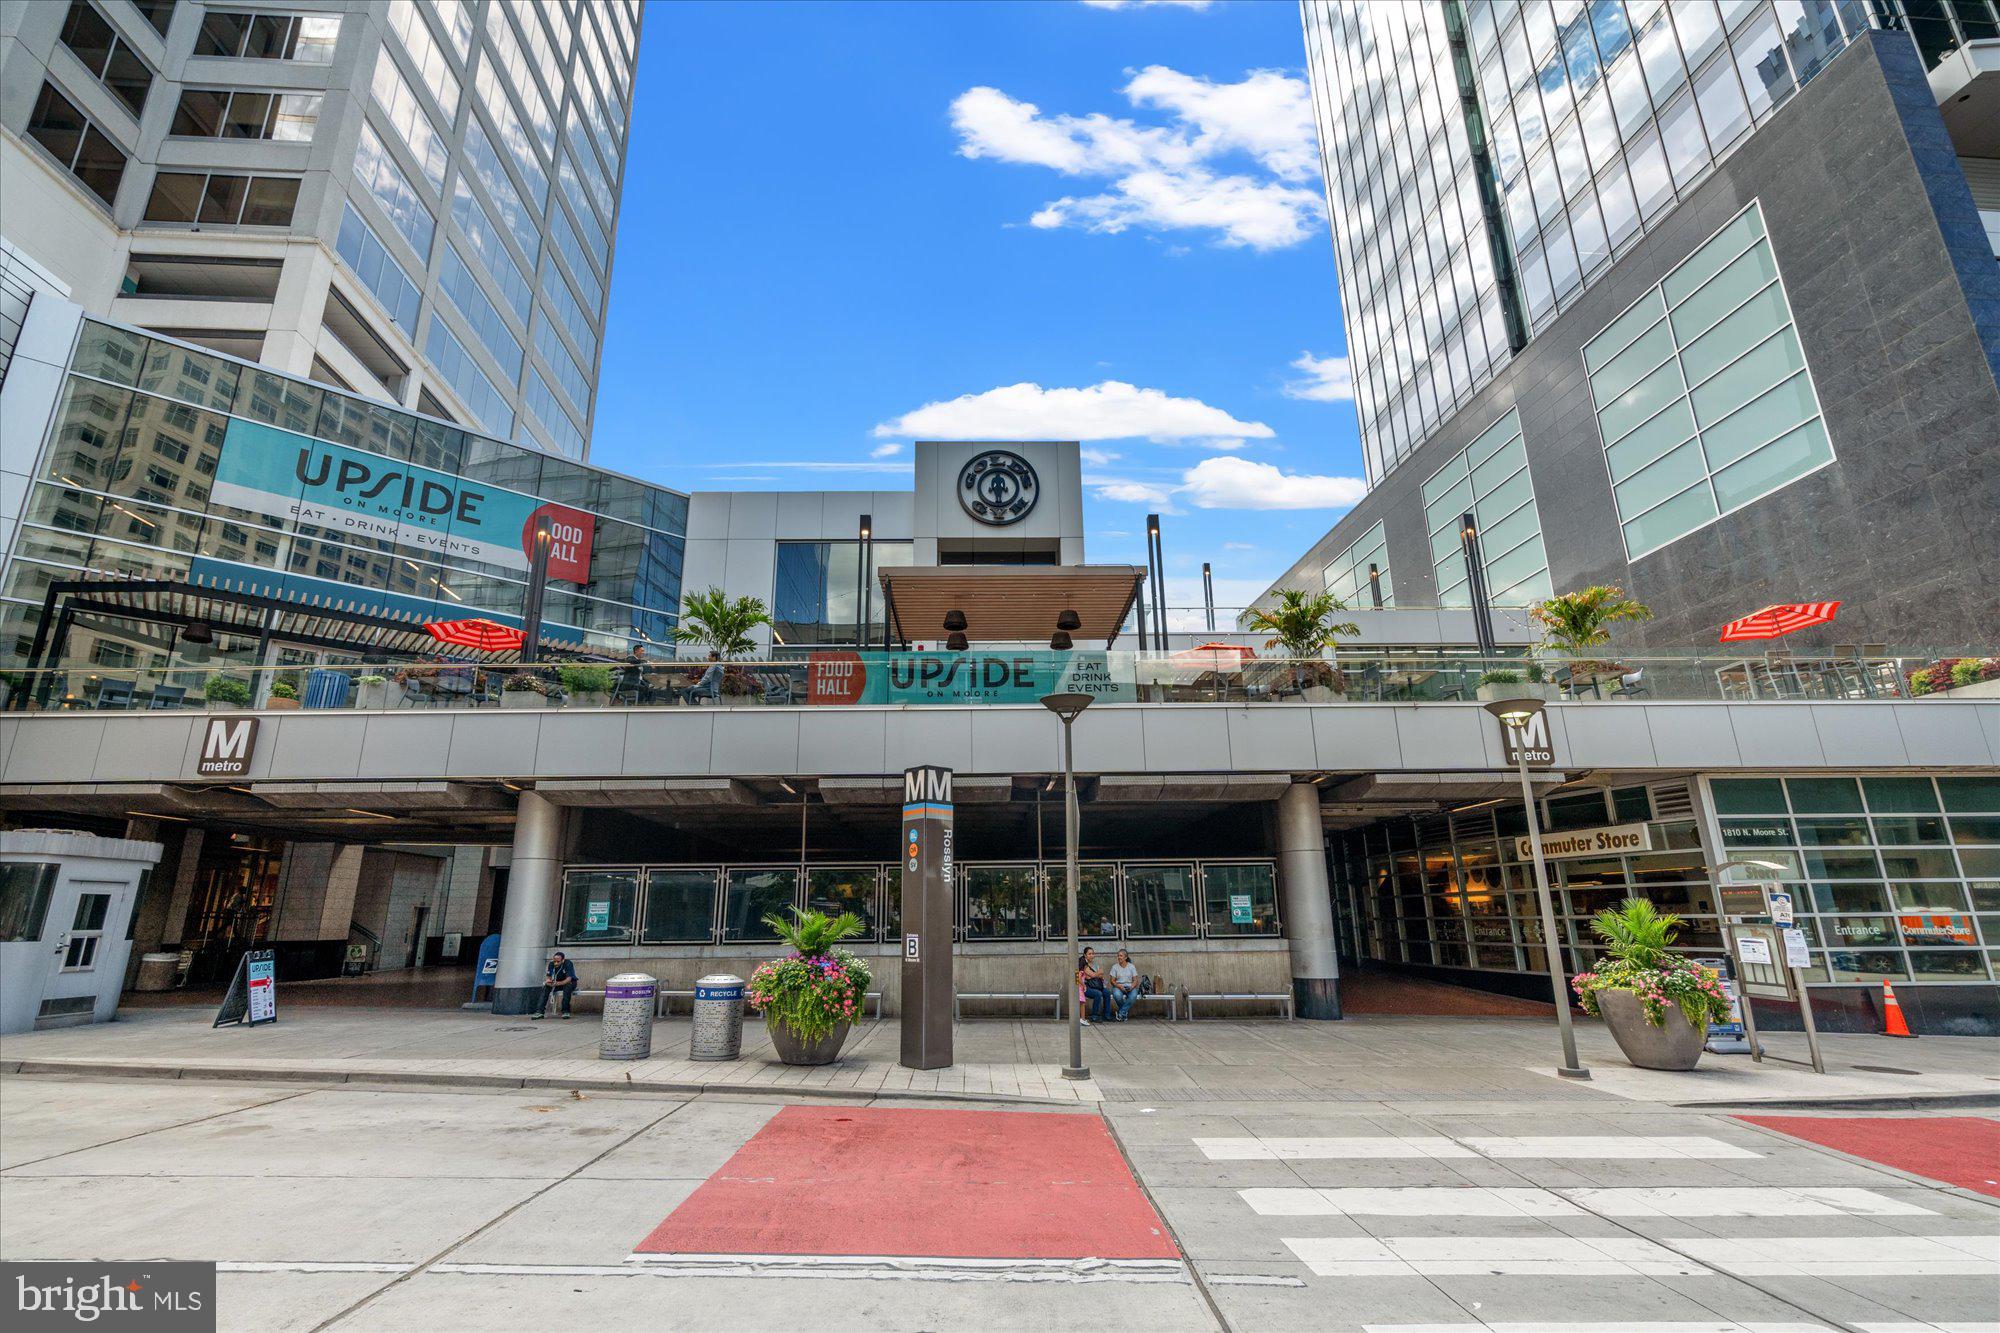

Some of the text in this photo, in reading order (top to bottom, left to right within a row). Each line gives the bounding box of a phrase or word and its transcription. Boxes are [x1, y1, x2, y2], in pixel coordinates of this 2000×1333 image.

[296, 448, 485, 525] UPSIDE
[343, 497, 437, 526] ON MOORE
[290, 505, 480, 555] EAT DRINK EVENTS
[551, 522, 583, 545] OOD
[550, 542, 578, 563] ALL
[817, 661, 853, 677] FOOD
[891, 658, 1034, 689] UPSIDE
[1077, 662, 1101, 671] EAT
[1072, 672, 1112, 682] DRINK
[816, 678, 852, 696] HALL
[1067, 683, 1119, 693] EVENTS
[1506, 710, 1549, 748] M
[205, 720, 252, 759] M
[201, 760, 242, 772] metro
[905, 769, 925, 802] M
[927, 769, 952, 802] M
[1596, 832, 1640, 849] Store
[1722, 828, 1789, 837] 1810 N. Moore St.
[942, 829, 953, 883] Rosslyn
[1475, 927, 1506, 936] Entrance
[1834, 926, 1881, 935] Entrance
[1901, 926, 1971, 936] CommuterStore
[909, 939, 917, 956] B
[252, 963, 272, 972] UPSIDE
